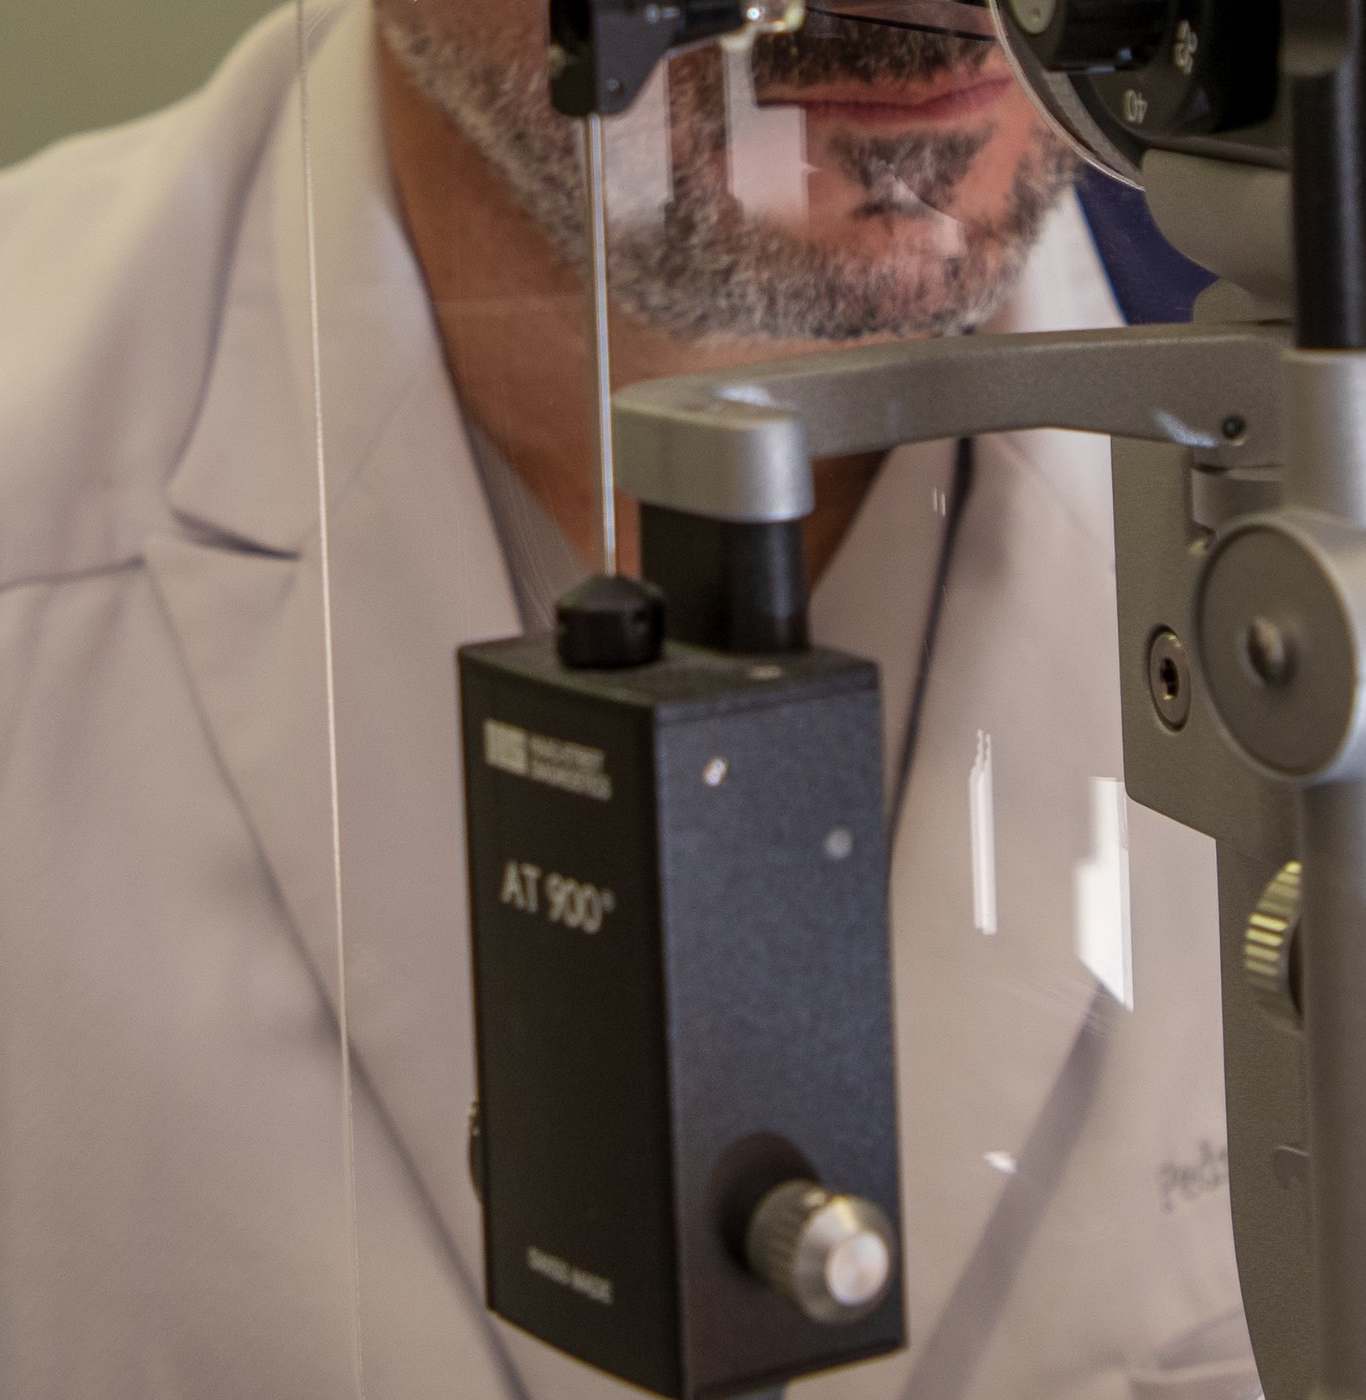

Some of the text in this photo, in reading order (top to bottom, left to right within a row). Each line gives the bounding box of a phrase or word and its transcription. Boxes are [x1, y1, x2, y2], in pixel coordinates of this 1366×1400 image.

[1174, 19, 1199, 75] 25
[1123, 89, 1148, 124] 40
[500, 859, 541, 914] AT
